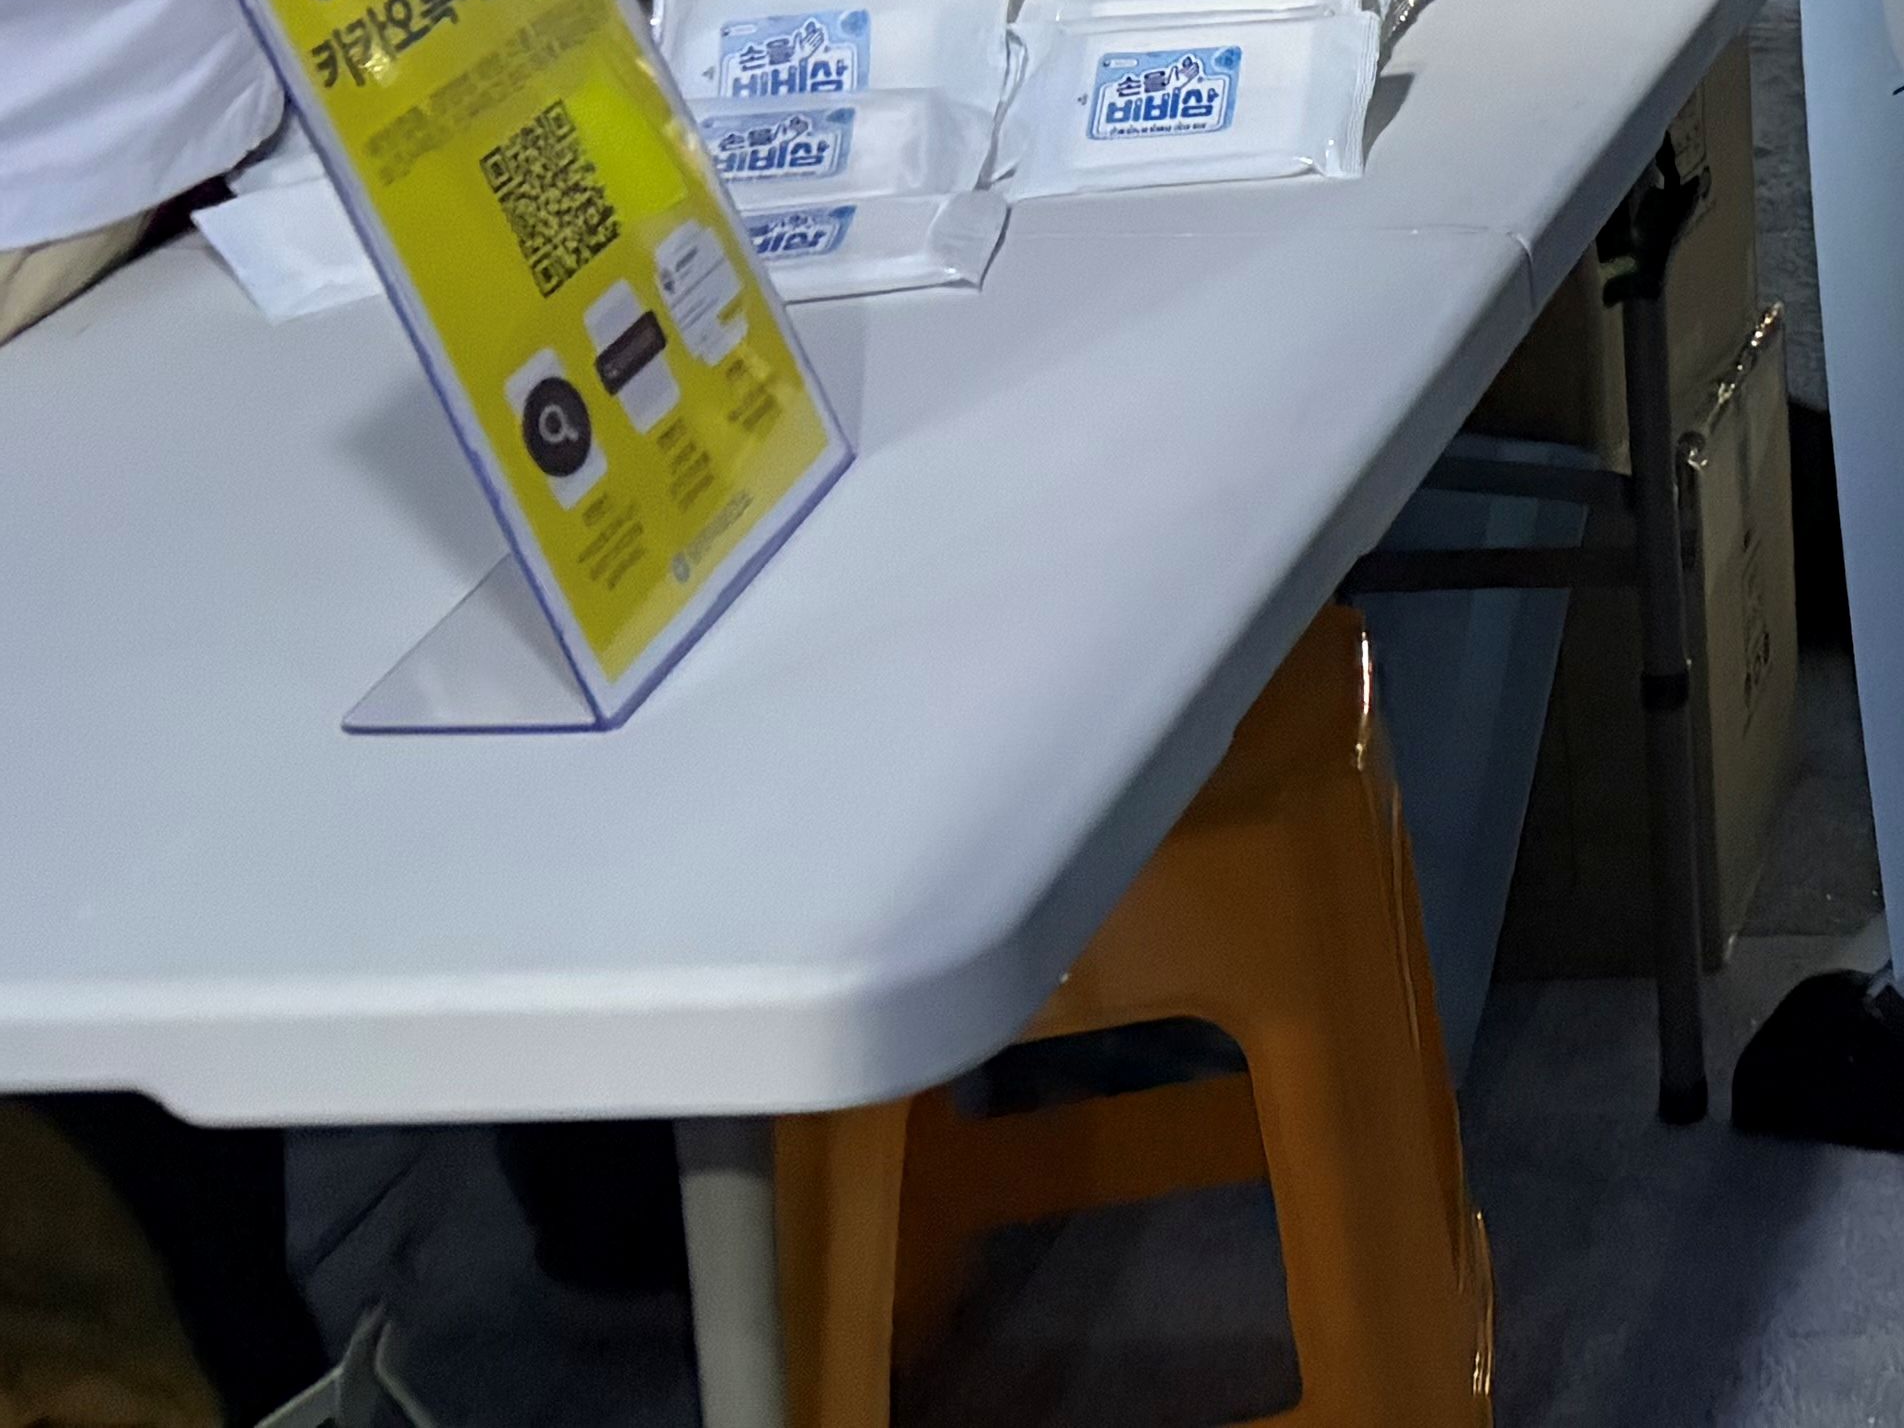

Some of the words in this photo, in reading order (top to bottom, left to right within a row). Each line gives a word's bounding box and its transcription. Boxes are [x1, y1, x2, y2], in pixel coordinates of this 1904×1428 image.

[740, 37, 795, 73] 손을
[1116, 70, 1167, 98] 손을
[1105, 85, 1220, 125] 비비삼
